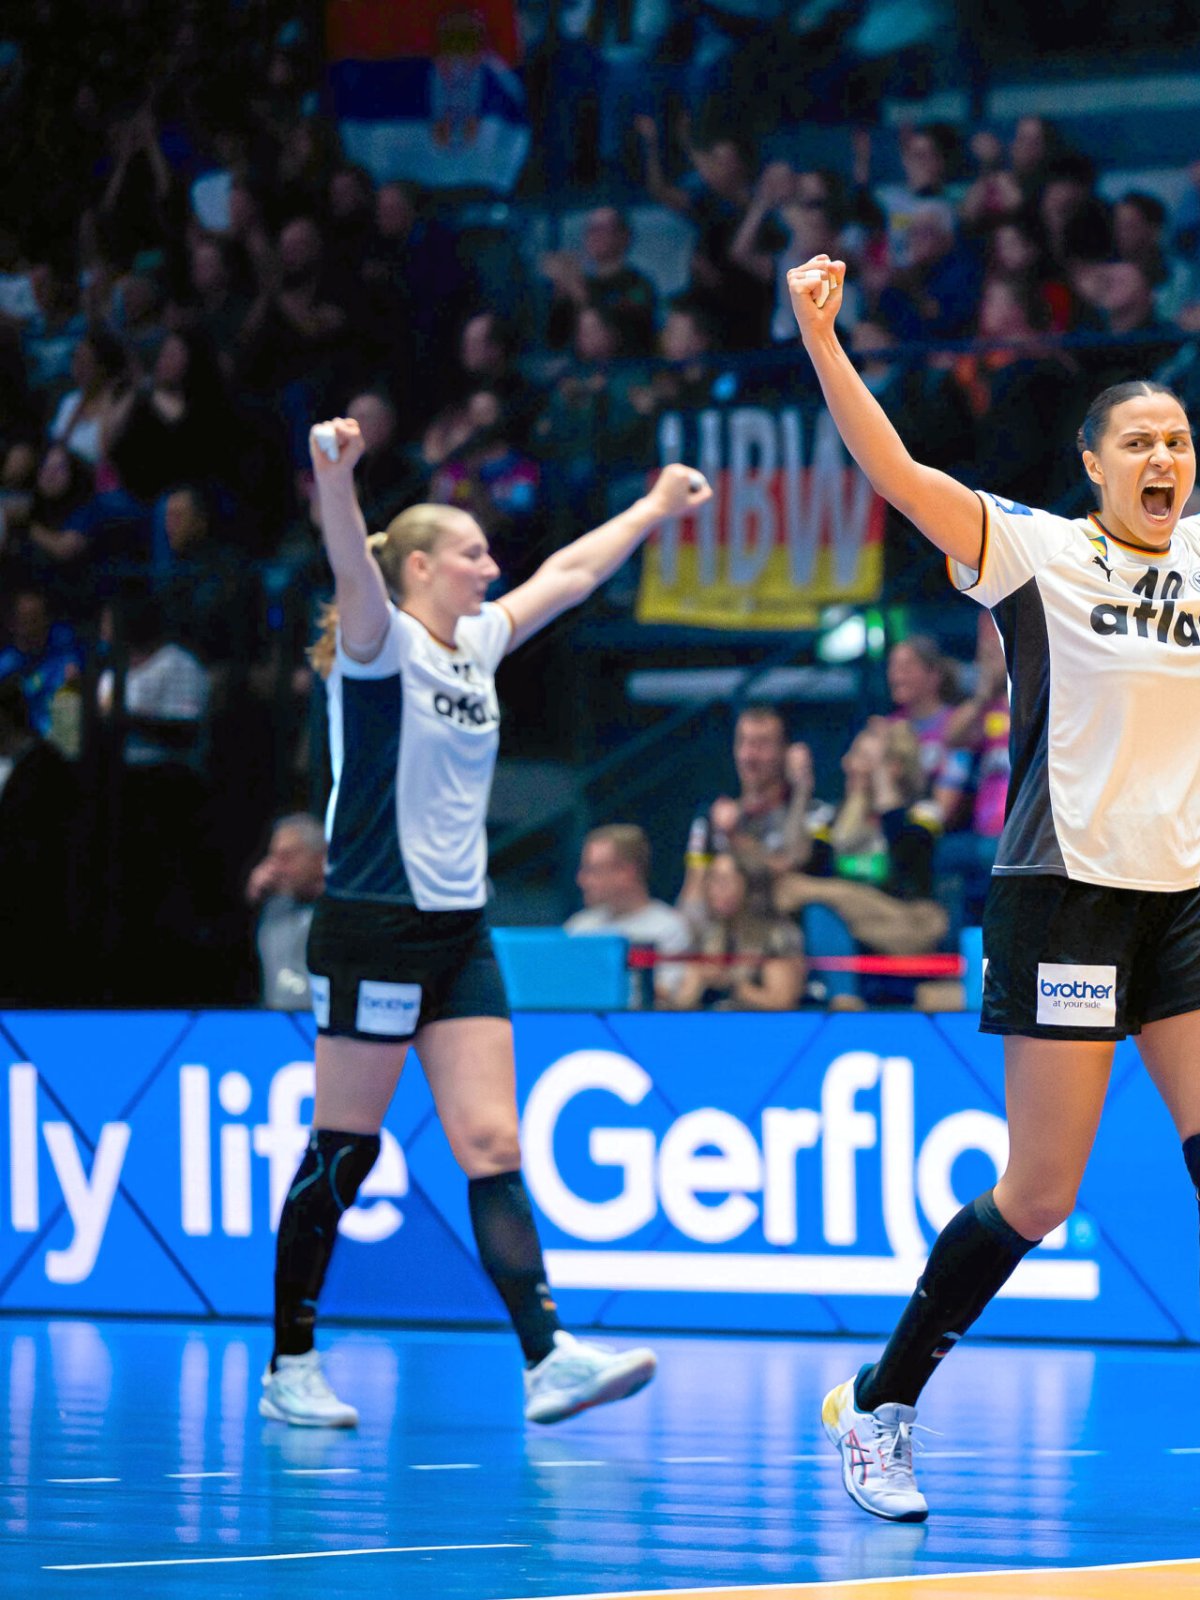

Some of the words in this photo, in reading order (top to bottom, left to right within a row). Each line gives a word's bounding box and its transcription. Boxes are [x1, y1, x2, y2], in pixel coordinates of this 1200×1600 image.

[1132, 566, 1183, 599] 10
[1040, 979, 1113, 999] brother
[1052, 1000, 1061, 1008] at
[1063, 1001, 1083, 1009] your
[1085, 1001, 1101, 1009] side
[519, 1049, 1067, 1259] Gerflo
